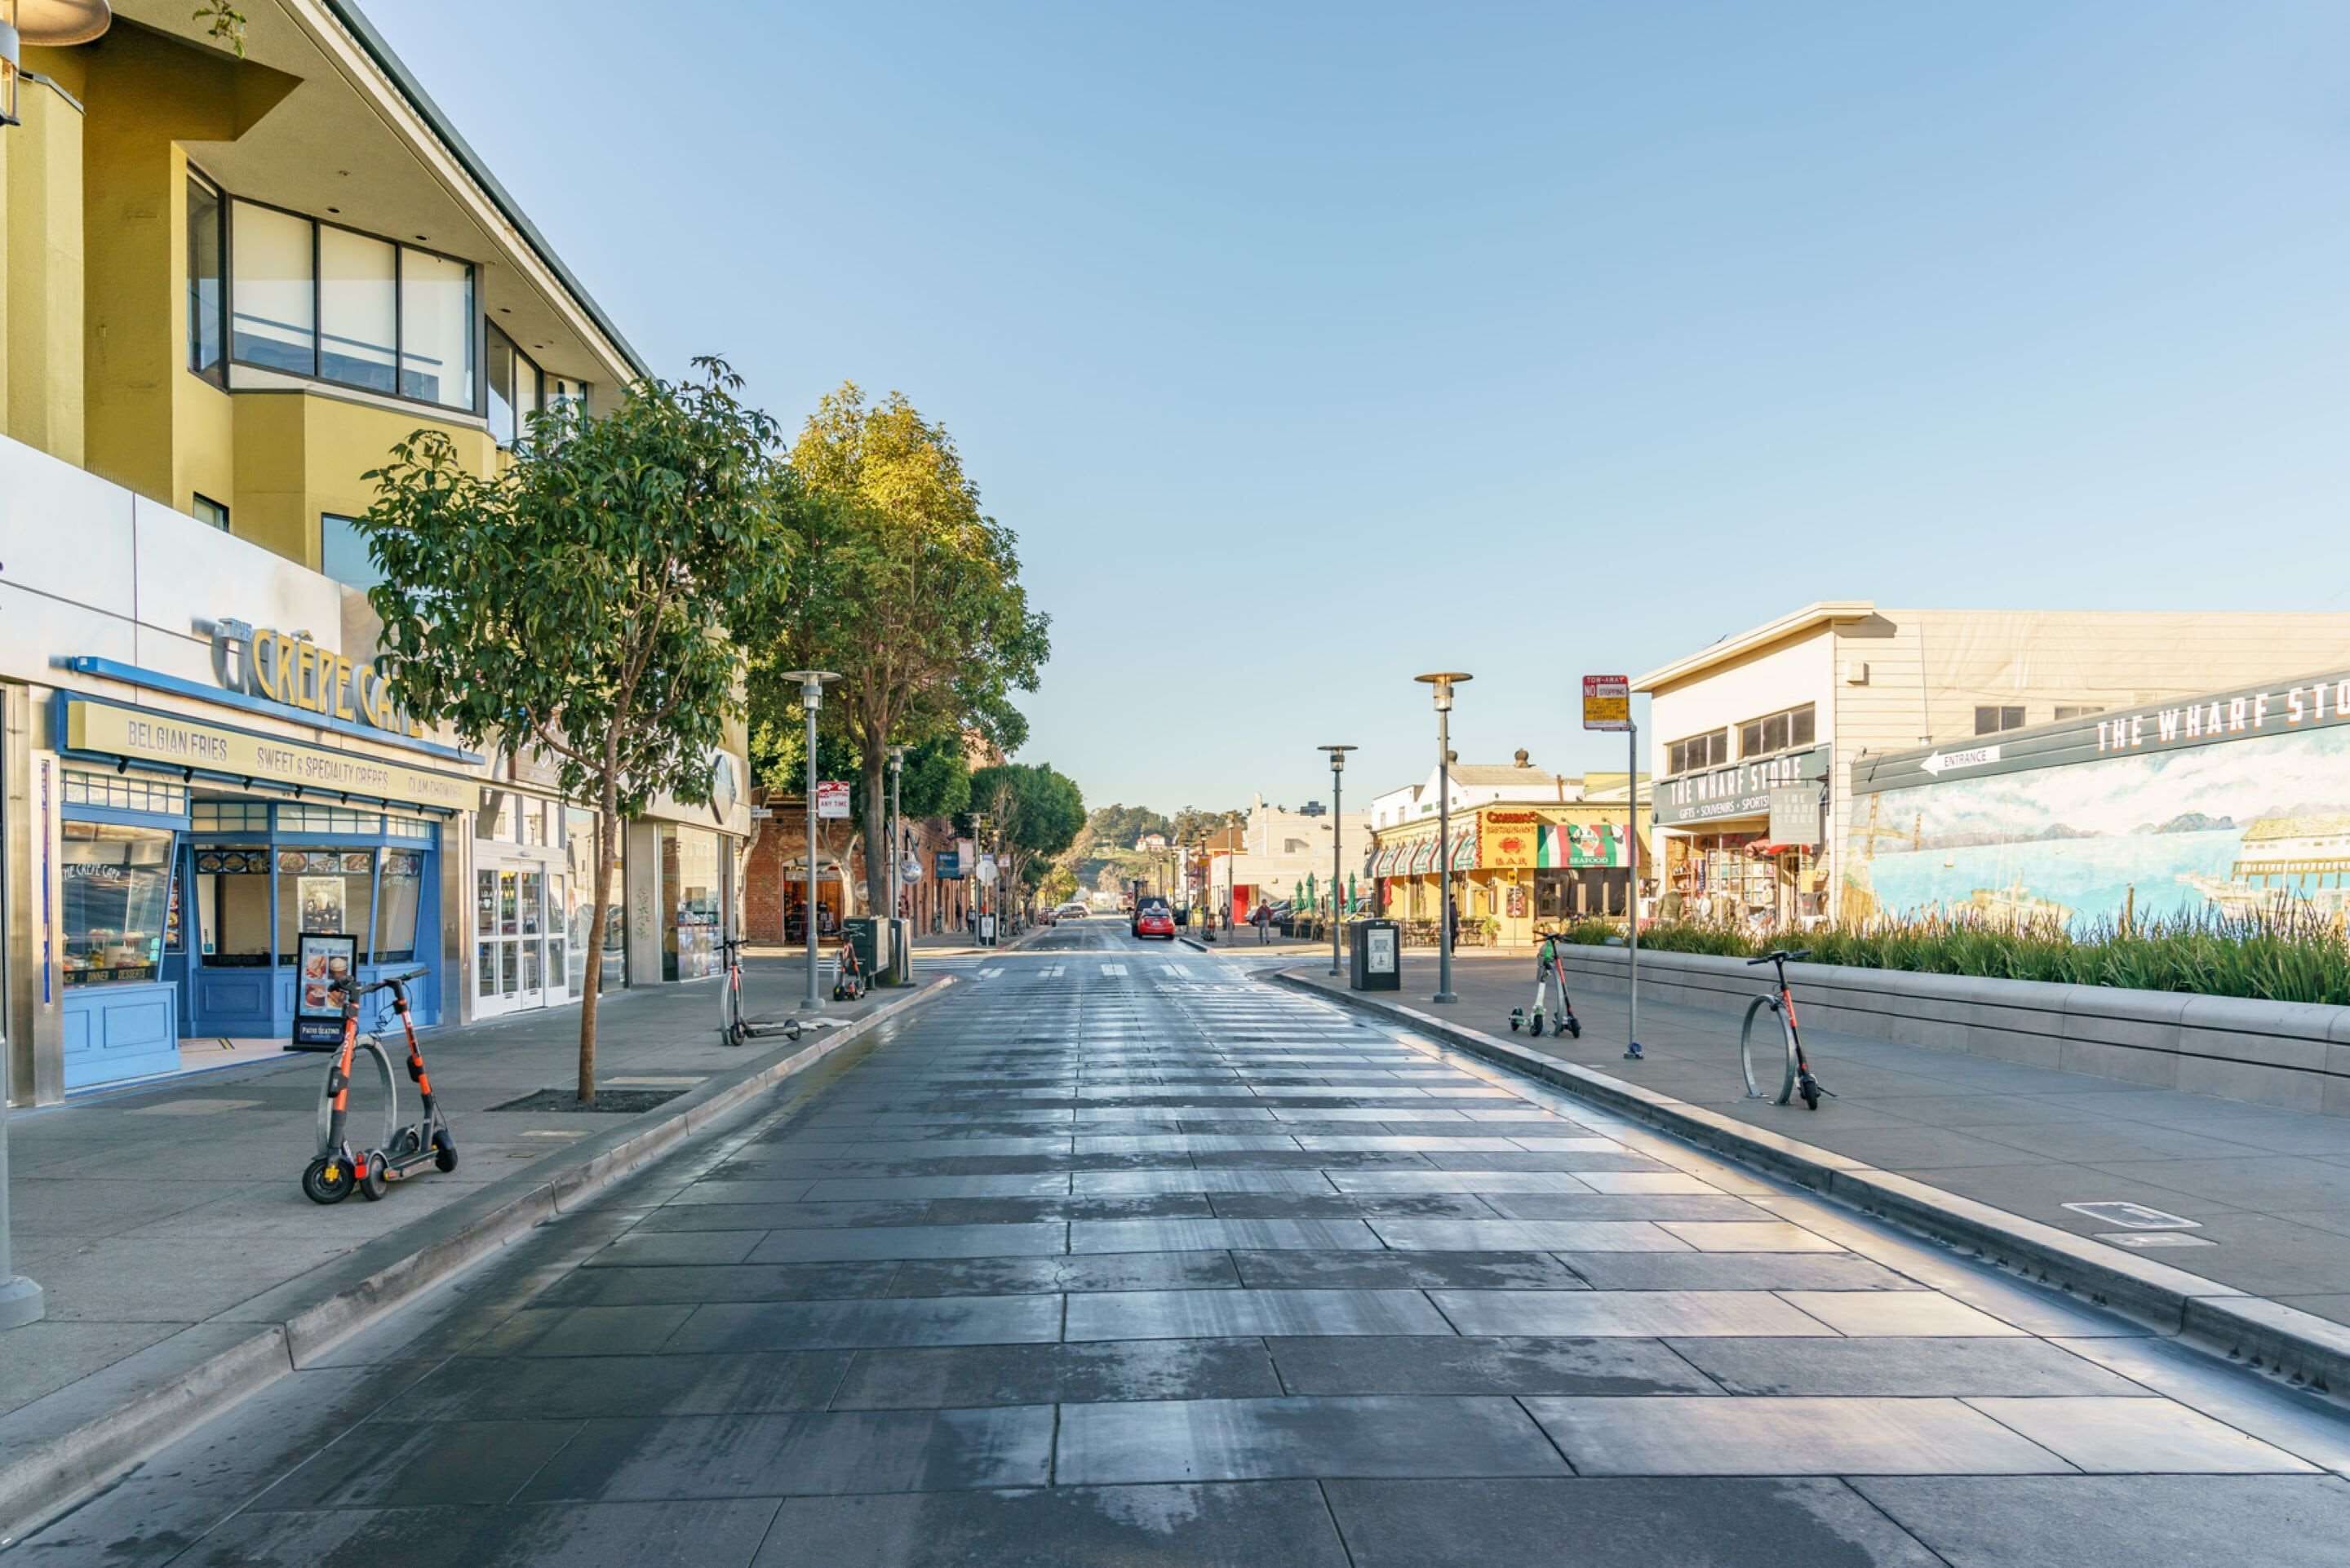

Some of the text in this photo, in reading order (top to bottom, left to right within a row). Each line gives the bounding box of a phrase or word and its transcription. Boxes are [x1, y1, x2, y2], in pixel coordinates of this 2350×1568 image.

[127, 720, 227, 762] BELGIAN FRIES
[2096, 714, 2144, 753] THE
[2158, 692, 2271, 743] WHARF
[256, 746, 295, 774] SWEET
[306, 756, 355, 785] SPECIALTY
[1944, 750, 1987, 768] ENTRANCE
[1671, 757, 1802, 806] THE WHARF STORE
[1679, 808, 1695, 819] GIFTS
[1700, 800, 1735, 816] SOUVENIRS
[1569, 857, 1608, 865] SEAFOOD
